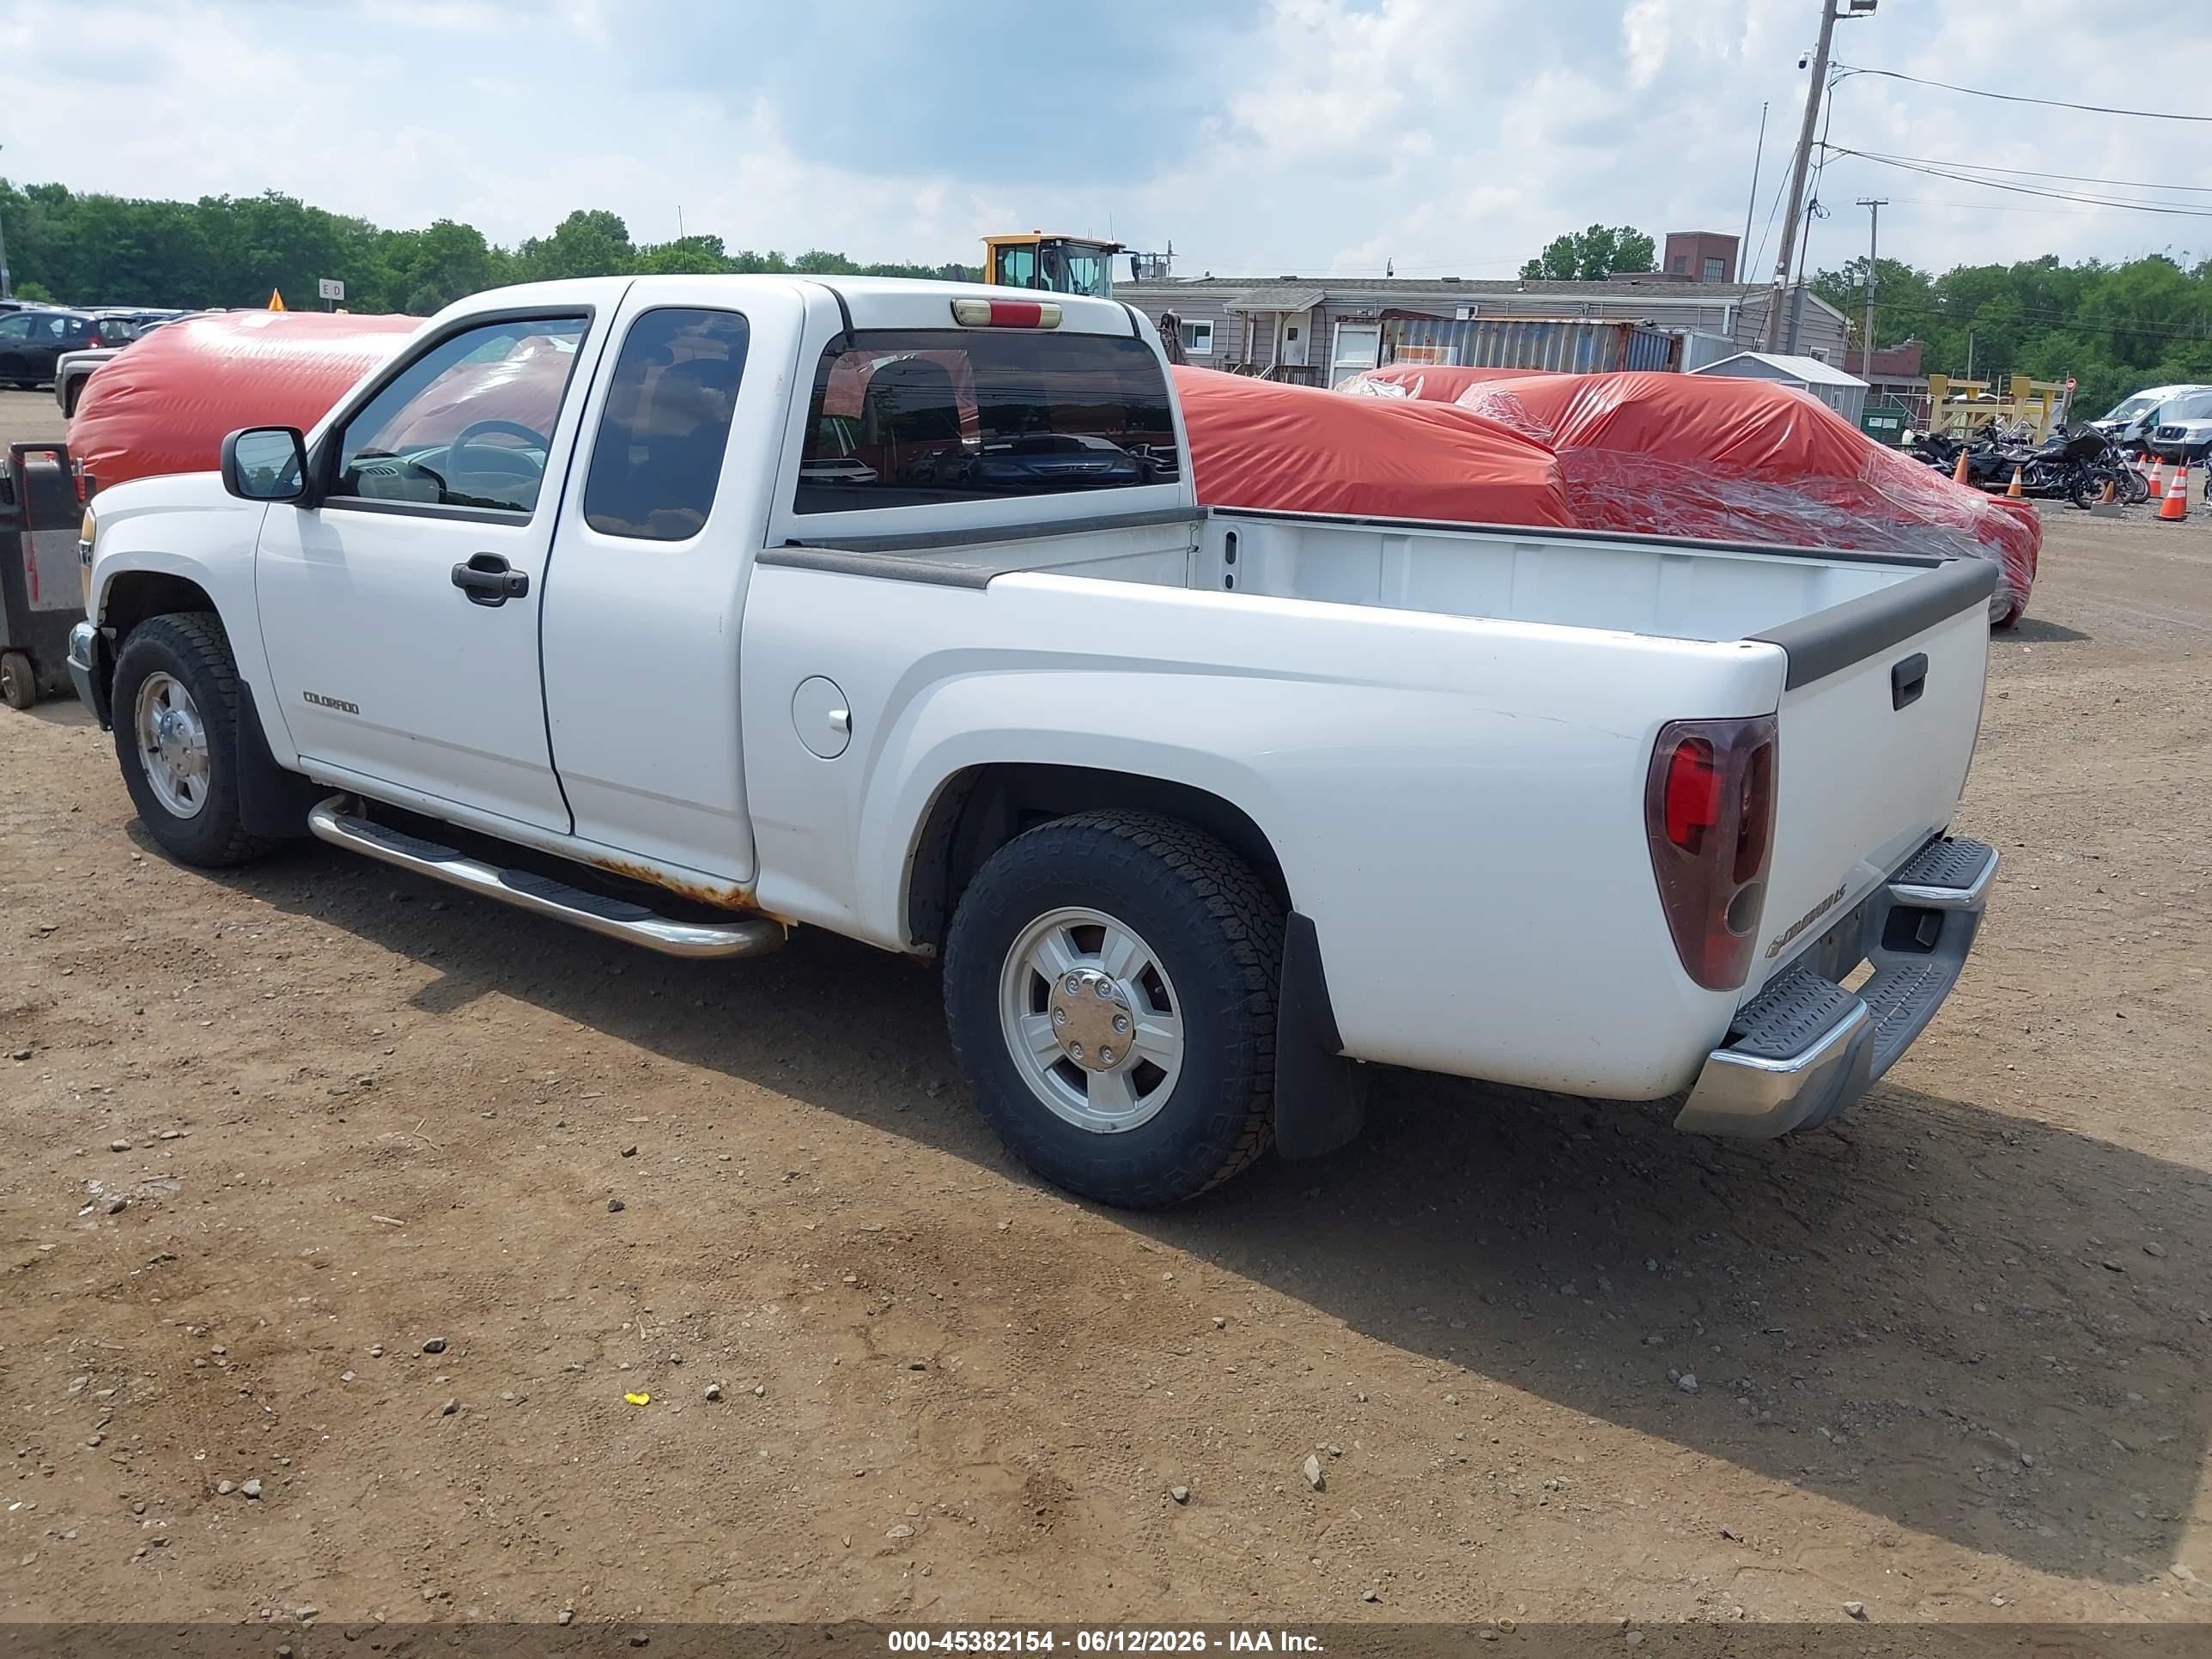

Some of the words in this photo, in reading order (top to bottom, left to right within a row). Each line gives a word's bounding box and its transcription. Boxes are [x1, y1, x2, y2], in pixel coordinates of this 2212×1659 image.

[323, 284, 329, 295] E
[333, 285, 340, 296] D
[302, 690, 360, 715] COLORADO
